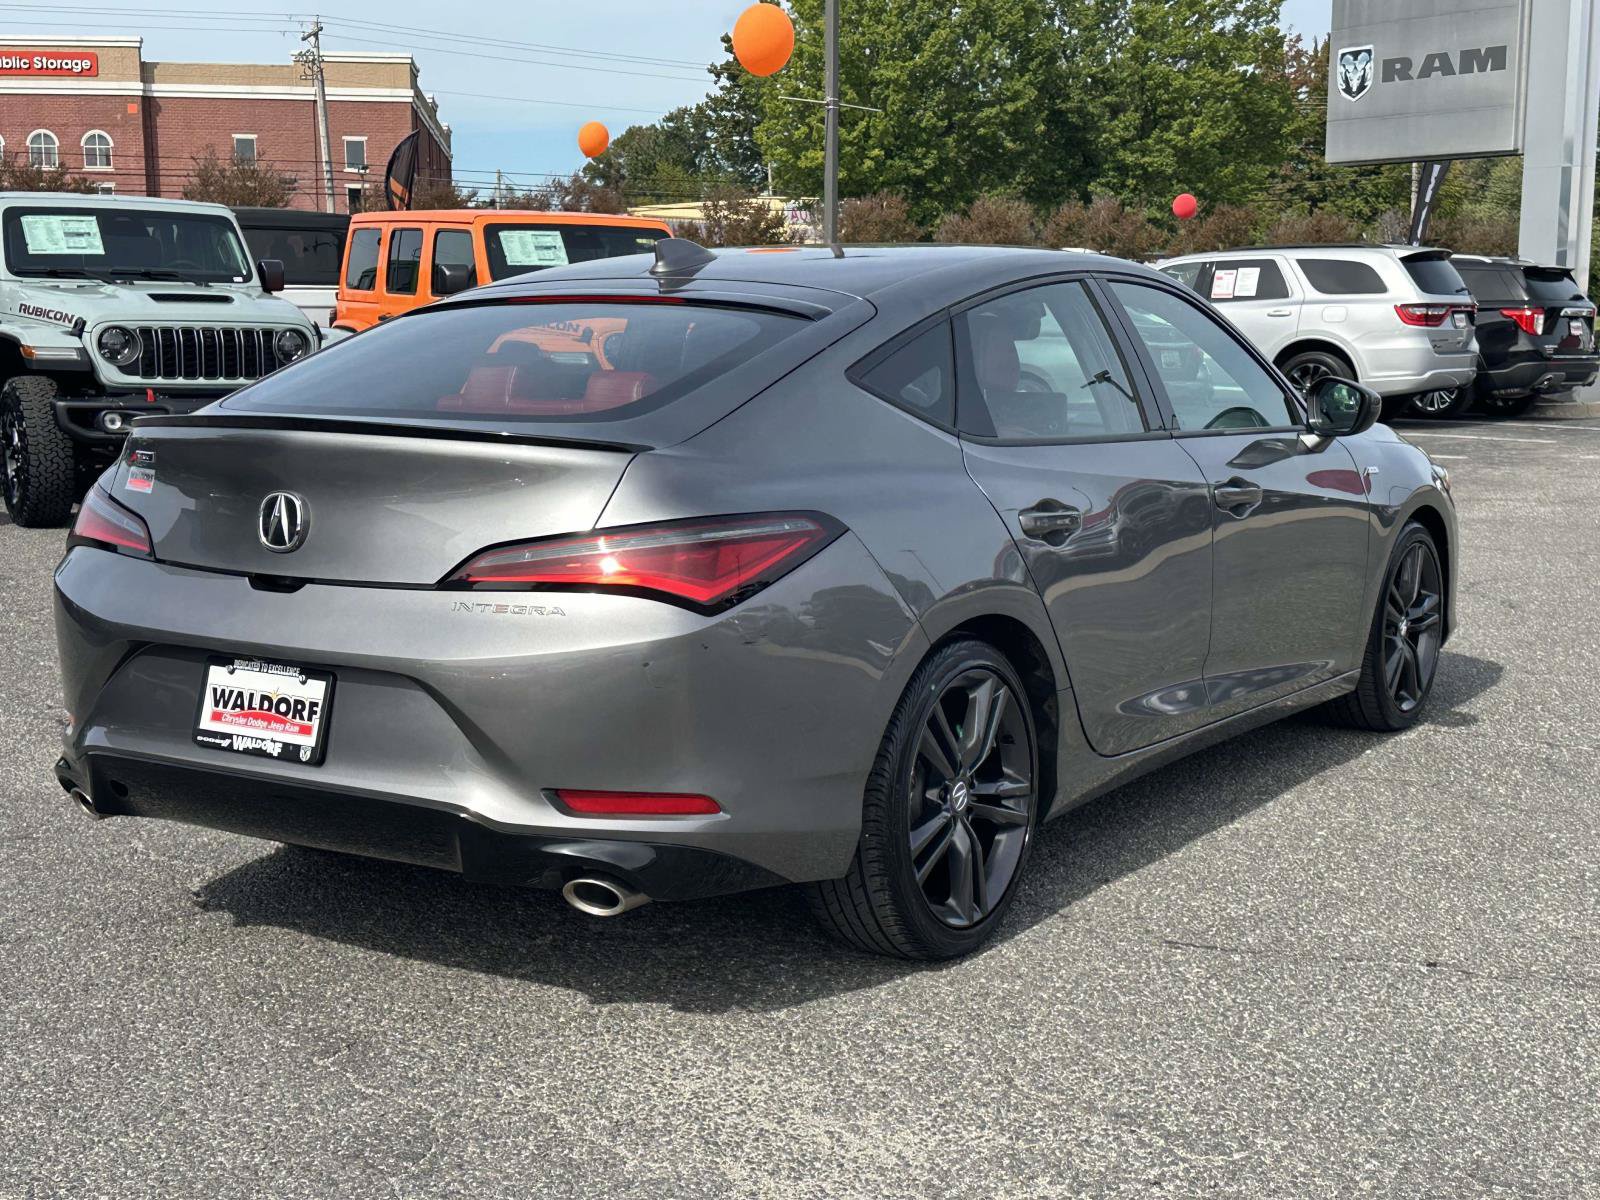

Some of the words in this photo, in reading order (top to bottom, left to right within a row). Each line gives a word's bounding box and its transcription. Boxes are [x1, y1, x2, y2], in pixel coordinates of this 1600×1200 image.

[0, 56, 30, 69] blic
[33, 56, 91, 72] Storage
[1381, 45, 1508, 83] RAM
[19, 303, 76, 324] RUBICON
[451, 602, 566, 616] INTEGRA
[261, 663, 268, 673] TO
[268, 664, 300, 677] EXCELLENCE
[212, 687, 319, 722] WALDORF
[221, 713, 246, 726] Chrysler
[247, 717, 267, 730] Dodge
[268, 721, 284, 732] Jeep
[284, 723, 300, 733] Ram
[233, 735, 283, 757] WALDORF
